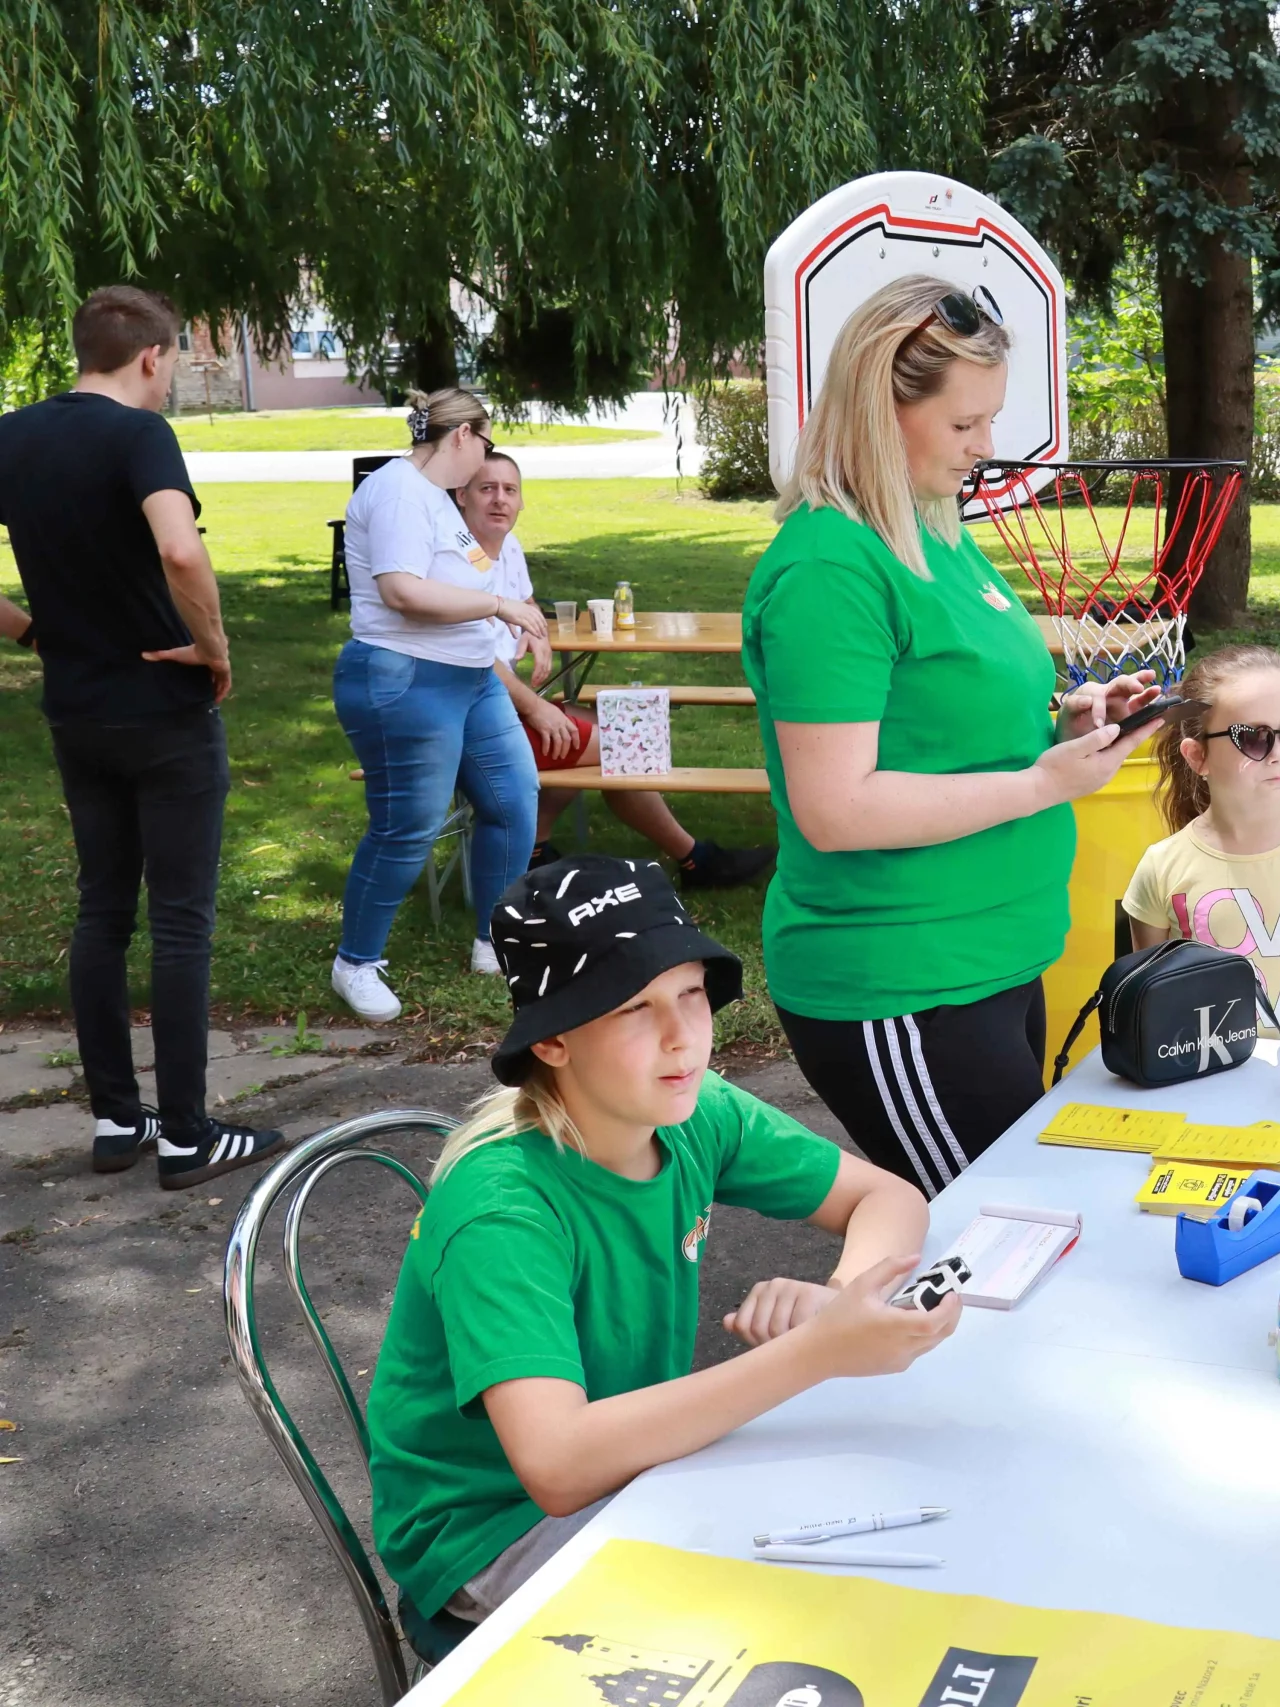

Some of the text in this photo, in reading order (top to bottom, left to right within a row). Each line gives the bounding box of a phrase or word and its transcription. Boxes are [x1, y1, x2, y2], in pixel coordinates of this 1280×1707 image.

[568, 882, 642, 926] AXE
[1158, 1026, 1256, 1058] Calvin Klein Jeans
[937, 1663, 995, 1707] LI
